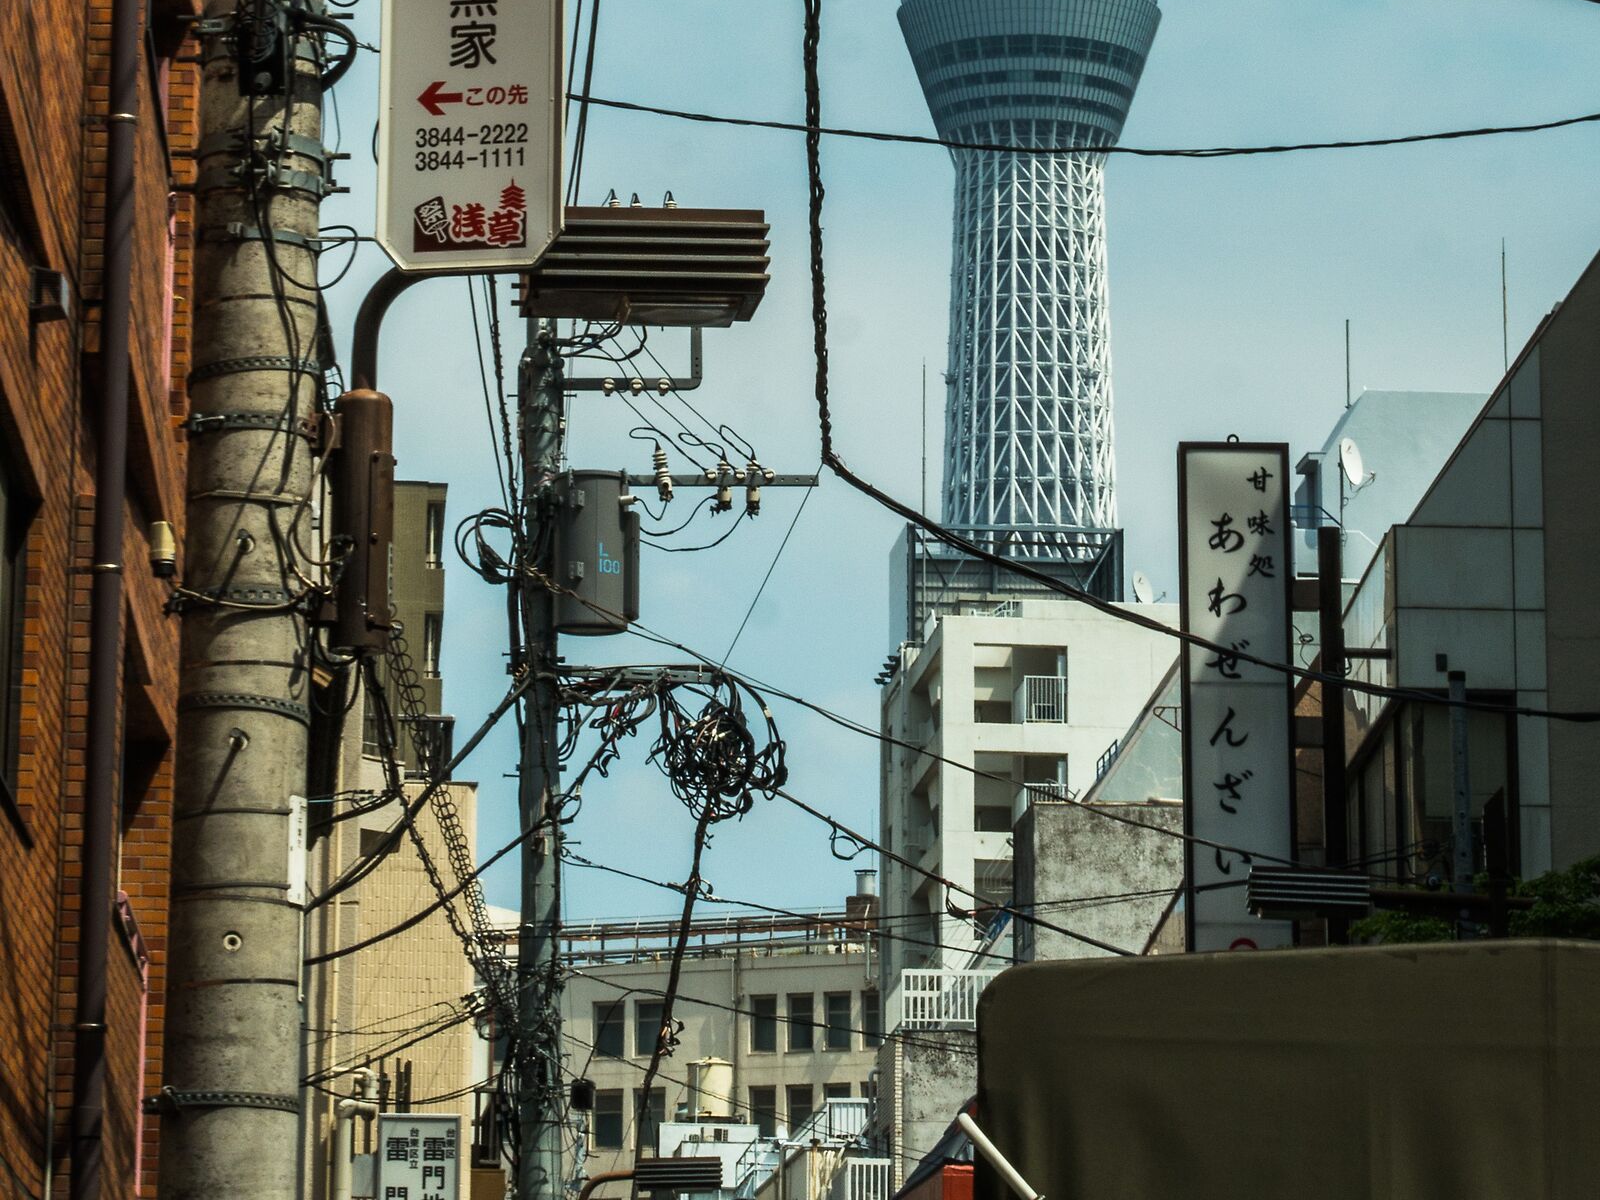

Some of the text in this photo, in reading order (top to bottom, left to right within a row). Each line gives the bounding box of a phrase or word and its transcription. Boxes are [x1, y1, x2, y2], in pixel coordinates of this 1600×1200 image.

[466, 84, 528, 106] この先
[415, 123, 528, 148] 3844-2222
[415, 147, 524, 171] 3844-1111
[419, 200, 444, 226] 祭
[451, 202, 522, 246] 浅草
[1246, 467, 1275, 577] 甘味処
[598, 543, 608, 557] L
[598, 559, 620, 574] 100
[1205, 512, 1251, 875] あわぜんざい
